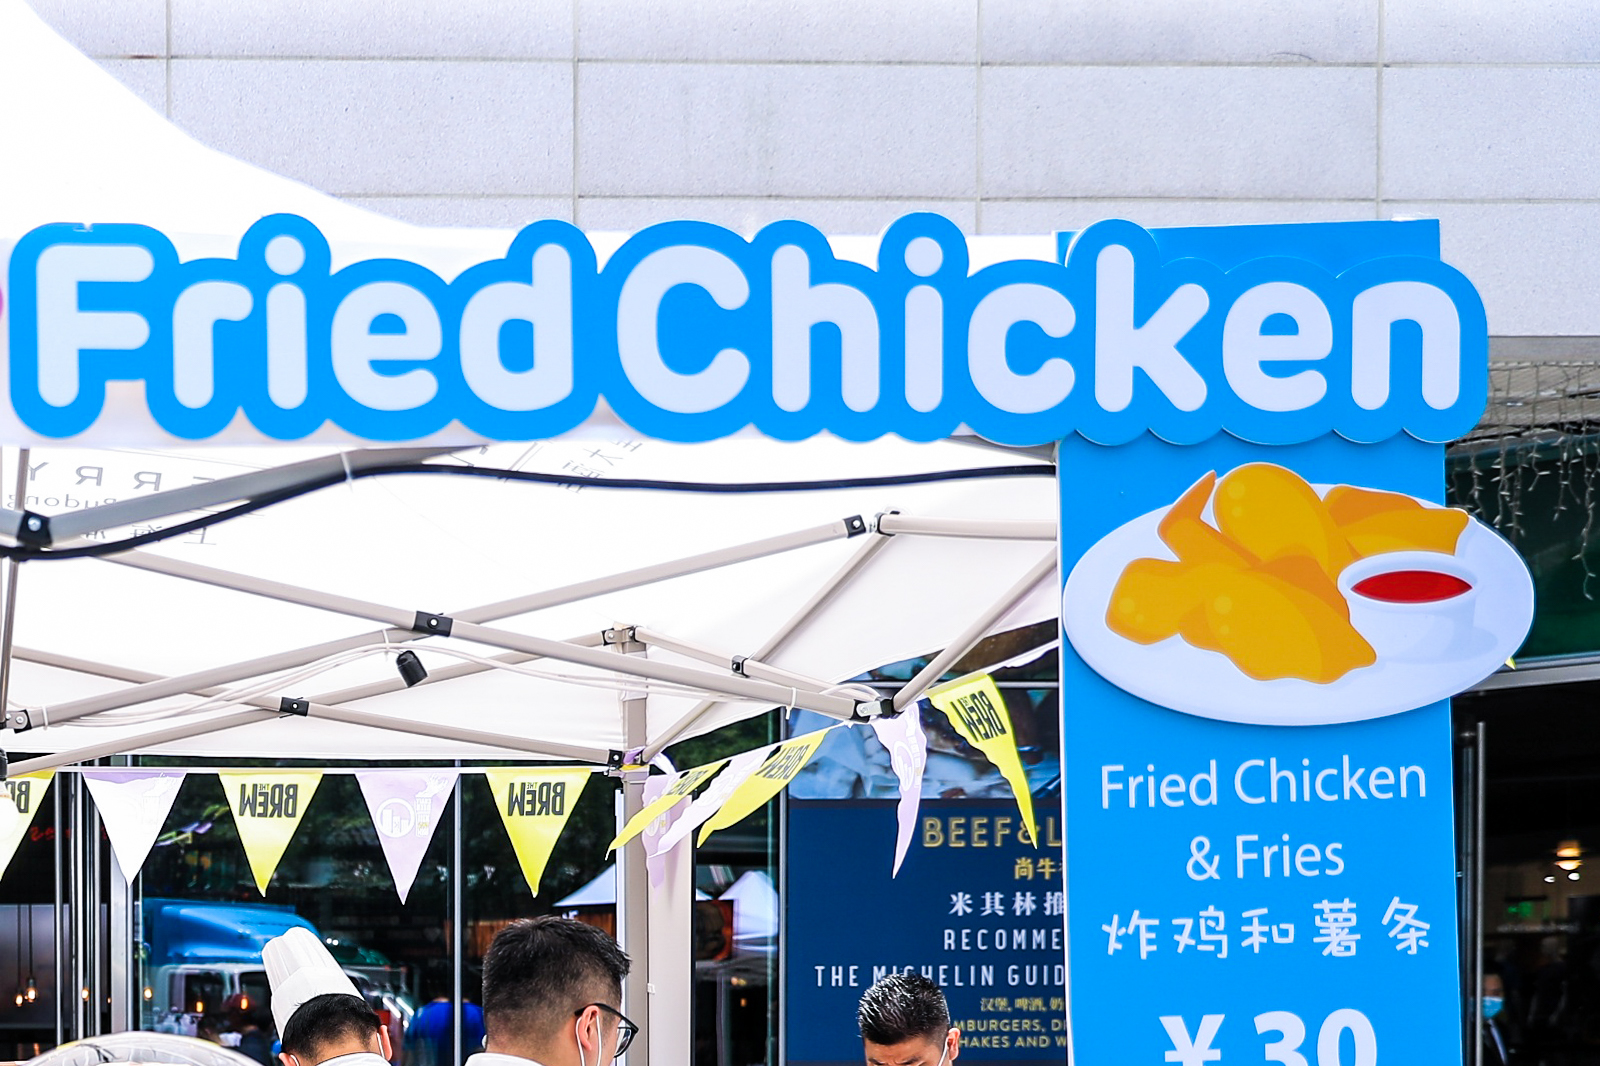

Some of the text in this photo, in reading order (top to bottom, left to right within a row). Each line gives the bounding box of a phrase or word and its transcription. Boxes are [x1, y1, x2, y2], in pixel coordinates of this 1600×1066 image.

[36, 234, 1461, 414] Fried Chicken
[1101, 754, 1427, 808] Fried Chicken
[1014, 857, 1063, 881] 尚牛
[1186, 833, 1345, 881] & Fries
[944, 929, 1062, 951] RECOMME
[1102, 896, 1432, 960] 炸鸡和薯条
[814, 965, 859, 987] THE
[1014, 1036, 1051, 1048] AND
